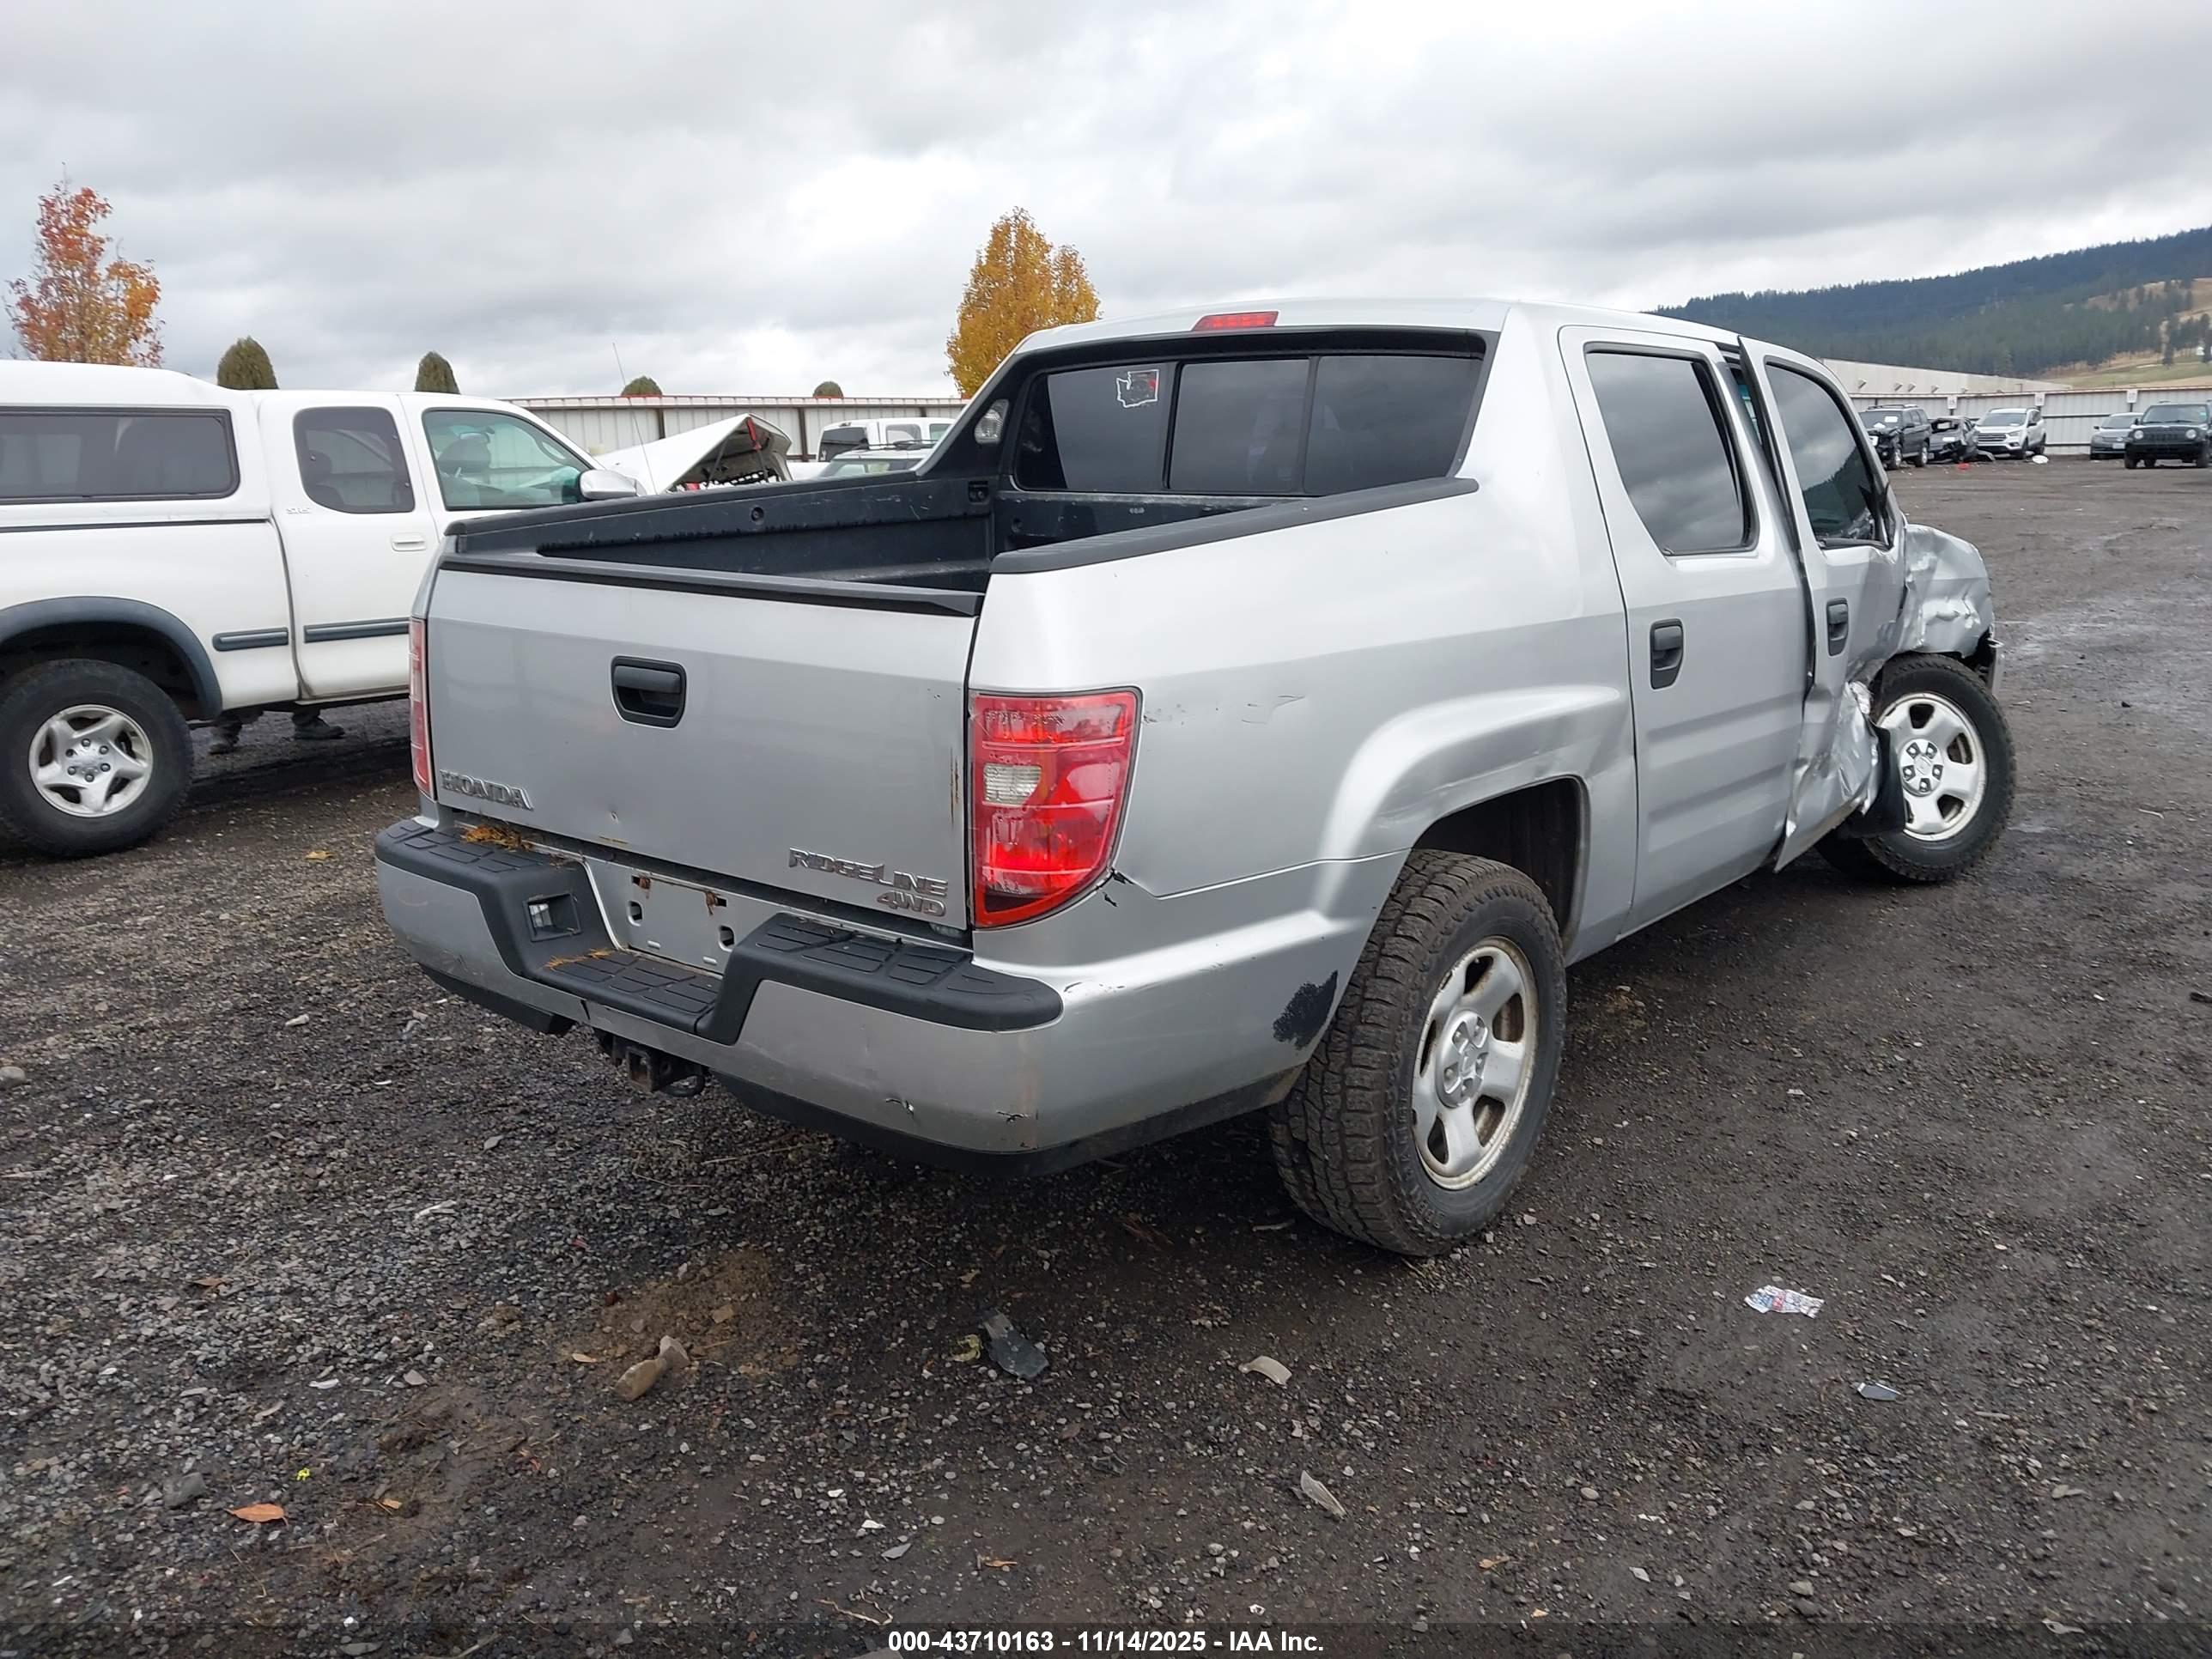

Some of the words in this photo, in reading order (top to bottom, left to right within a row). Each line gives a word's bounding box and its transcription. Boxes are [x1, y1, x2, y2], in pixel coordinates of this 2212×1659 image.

[439, 769, 534, 811] HONDA
[787, 847, 949, 896] RIDGELINE
[876, 890, 946, 917] 4WD
